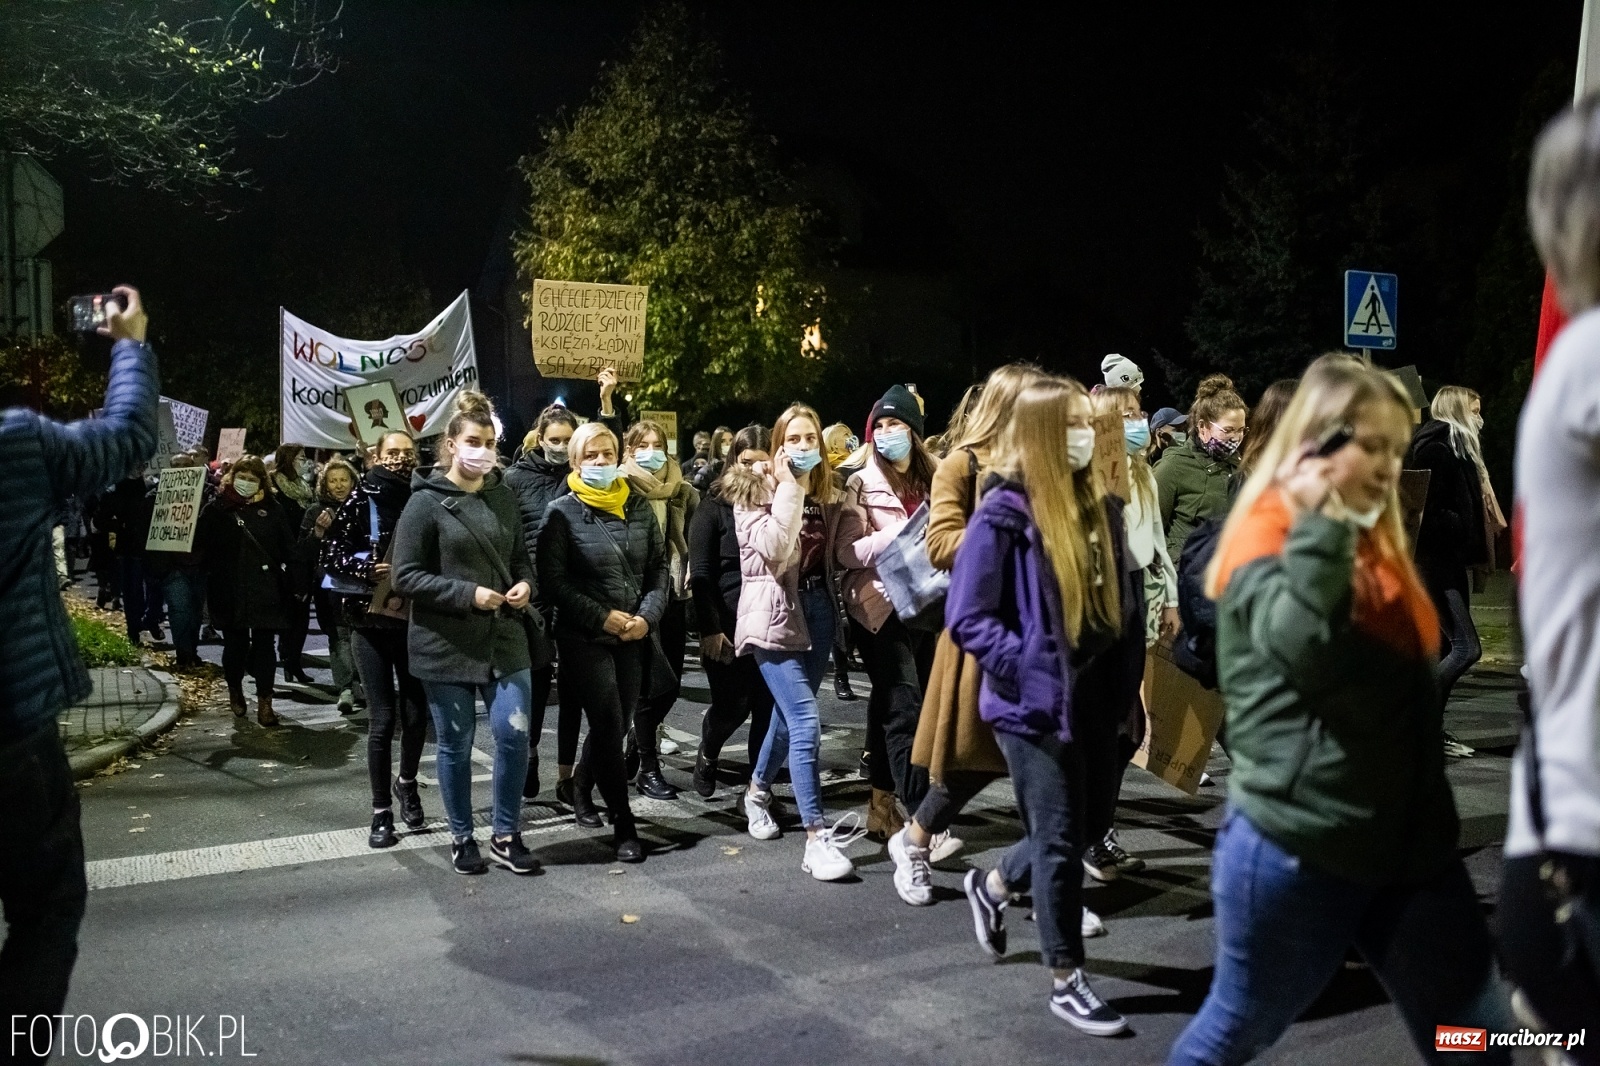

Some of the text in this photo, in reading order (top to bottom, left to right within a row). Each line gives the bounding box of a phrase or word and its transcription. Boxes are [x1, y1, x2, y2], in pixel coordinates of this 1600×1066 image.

[595, 289, 644, 311] DZIECI?
[572, 357, 585, 375] Z
[292, 377, 348, 413] koch
[1156, 750, 1195, 778] SUPER
